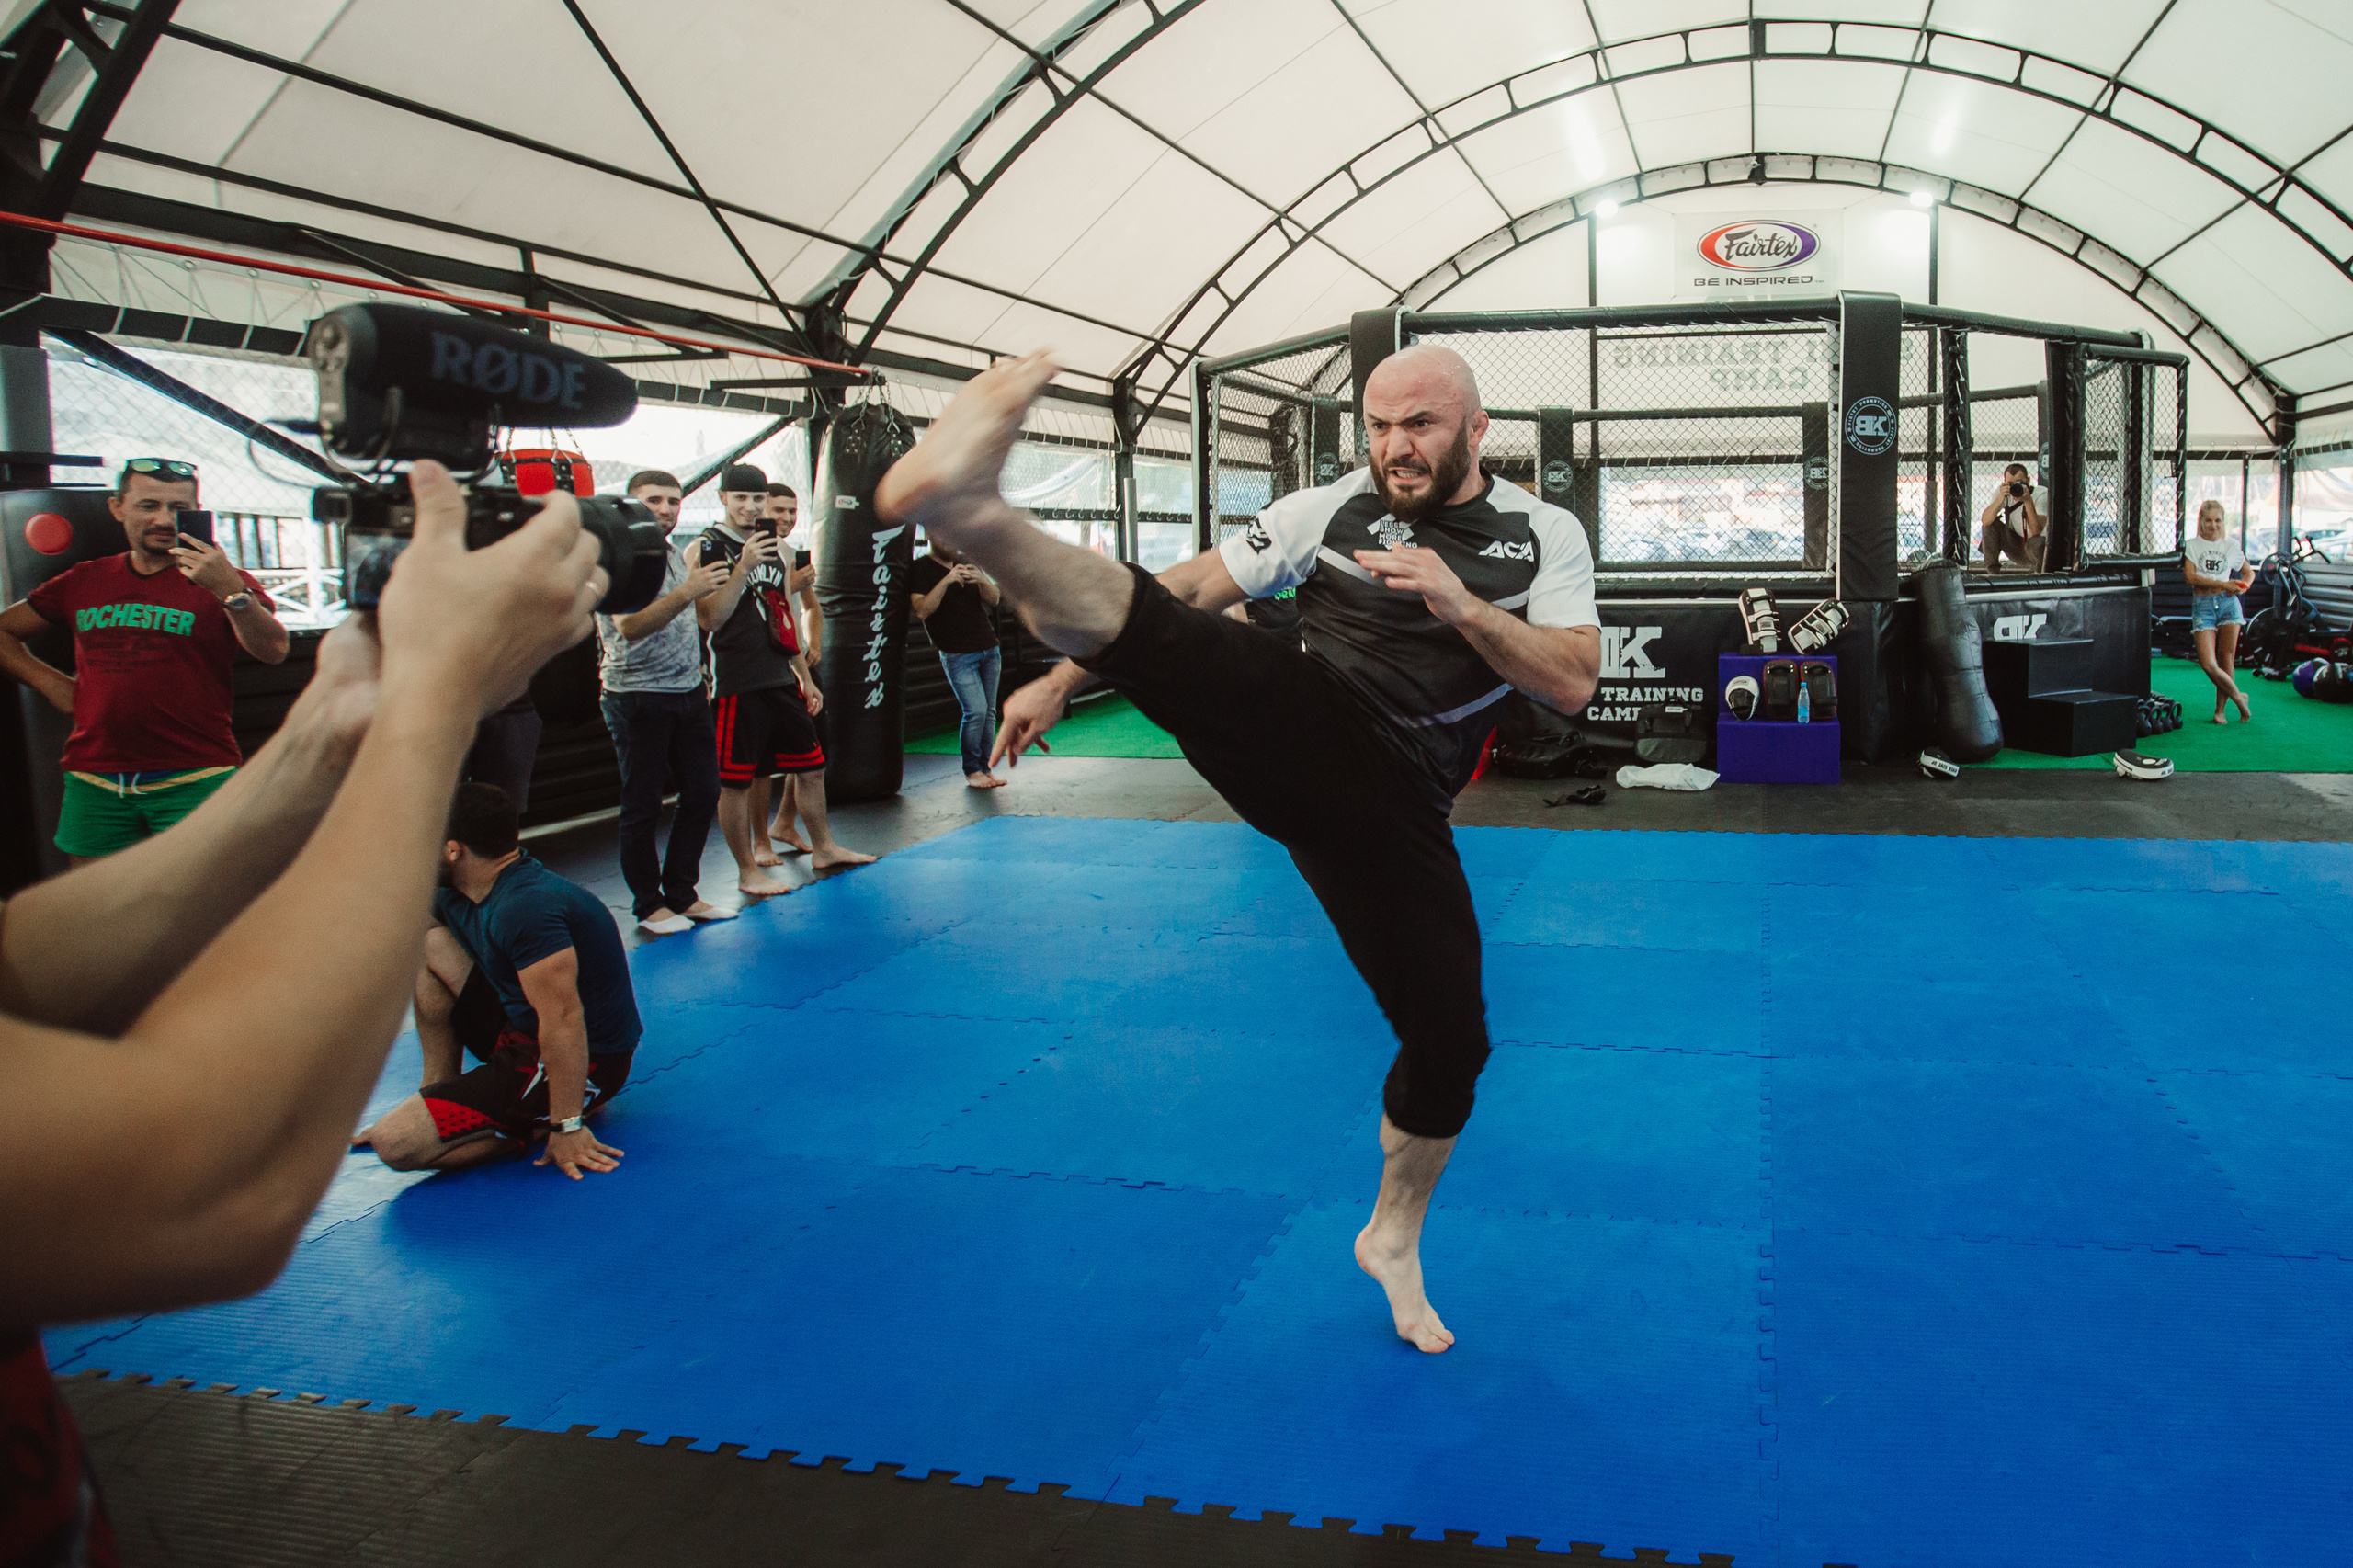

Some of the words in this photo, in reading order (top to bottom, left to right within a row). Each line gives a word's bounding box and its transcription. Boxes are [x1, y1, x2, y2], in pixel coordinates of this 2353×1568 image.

[1724, 227, 1798, 261] Fairtex
[1694, 278, 1720, 287] BE
[1725, 276, 1813, 286] INSPIRED
[432, 330, 585, 410] RØDE
[1379, 540, 1418, 549] FIGING
[1478, 540, 1535, 562] ACA
[862, 523, 906, 710] Fairtex
[1600, 687, 1704, 702] TRAINING
